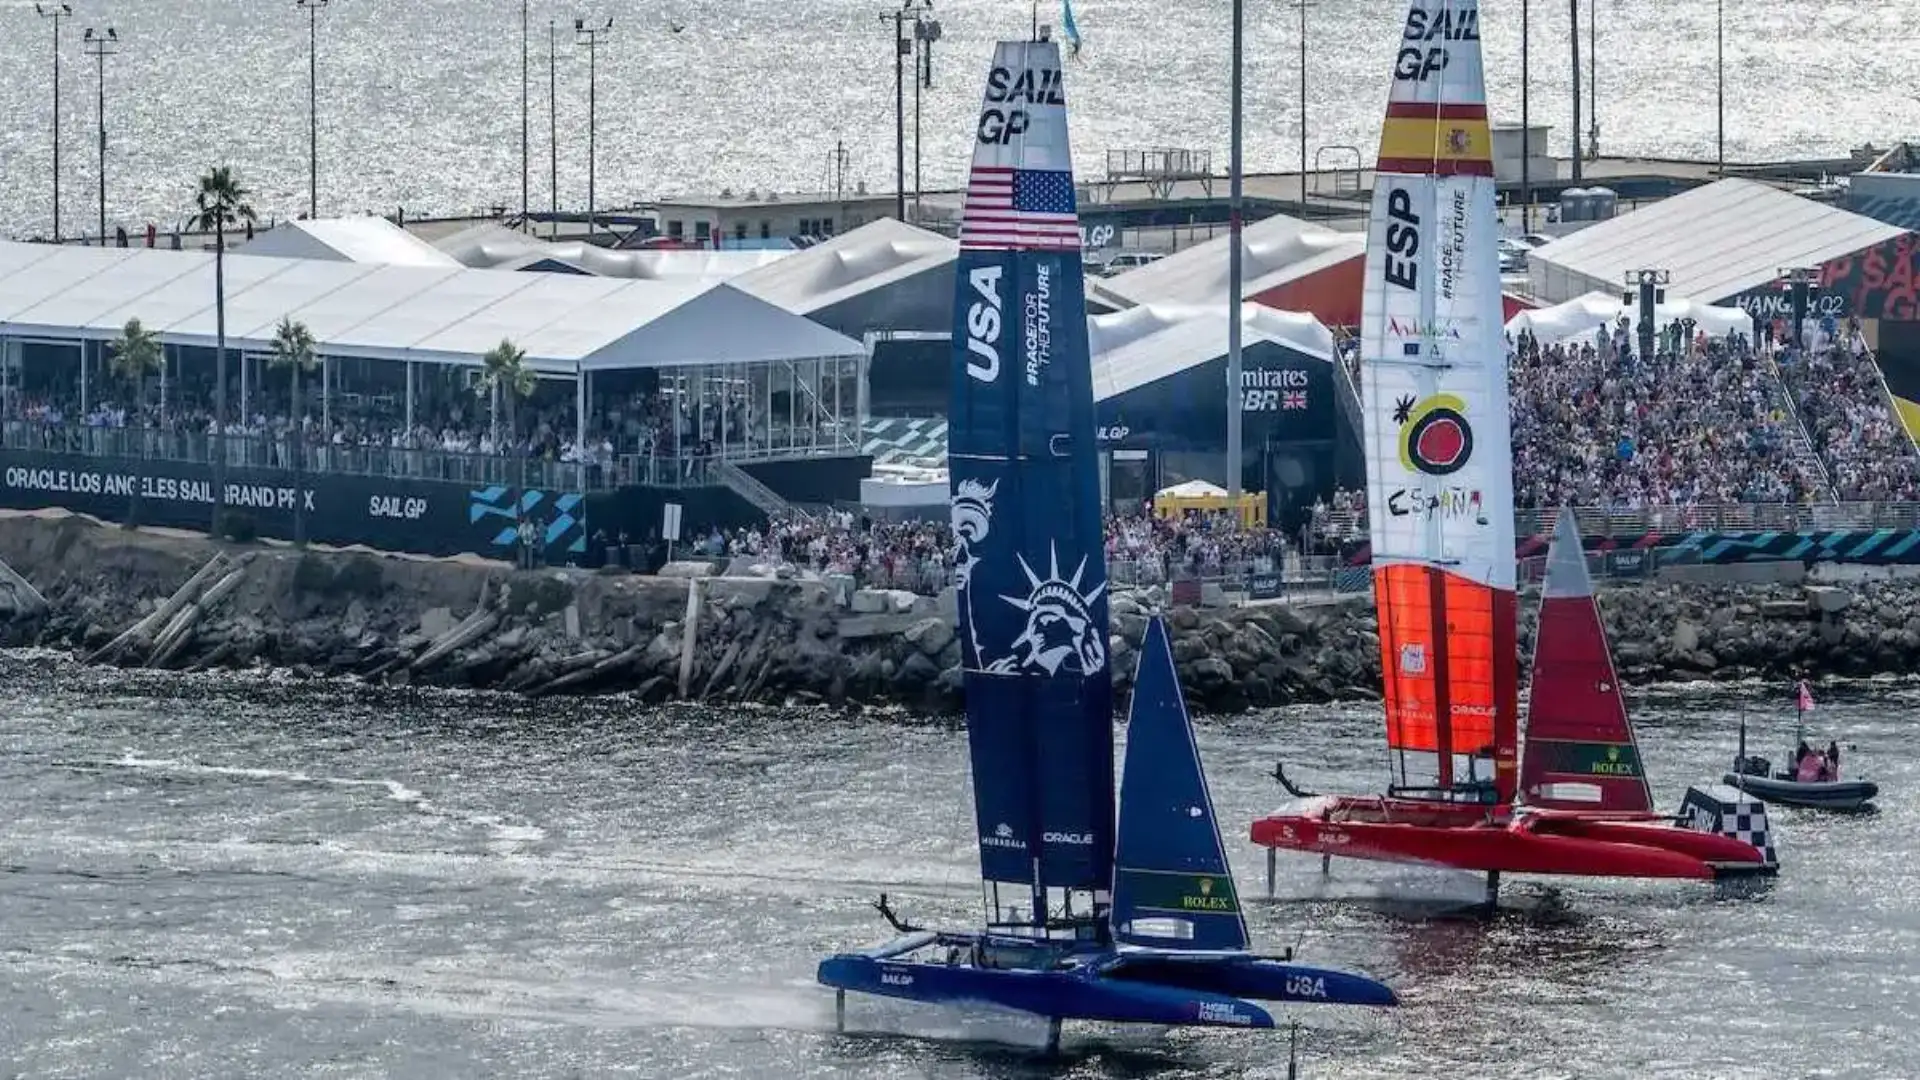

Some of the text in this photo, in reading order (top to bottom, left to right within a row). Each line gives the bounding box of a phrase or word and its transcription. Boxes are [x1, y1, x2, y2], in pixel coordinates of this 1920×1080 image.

[1405, 9, 1480, 40] SAIL
[1394, 48, 1449, 81] GP
[985, 67, 1065, 105] SAIL
[977, 109, 1029, 145] GP
[1385, 188, 1420, 291] ESP
[967, 265, 1002, 384] USA
[1037, 263, 1050, 365] THEFUTURE
[1025, 292, 1038, 387] #RACEFOR
[1226, 366, 1308, 387] mirates
[1241, 389, 1279, 411] BR
[6, 467, 69, 491] ORACLE
[71, 471, 101, 493] LOS
[180, 481, 215, 503] SAIL
[277, 488, 315, 511] PRX
[1450, 705, 1497, 717] ORACLE
[1592, 761, 1632, 774] ROLEX
[1042, 831, 1094, 844] ORACLE
[1183, 895, 1228, 909] ROLEX
[1286, 976, 1328, 998] USA
